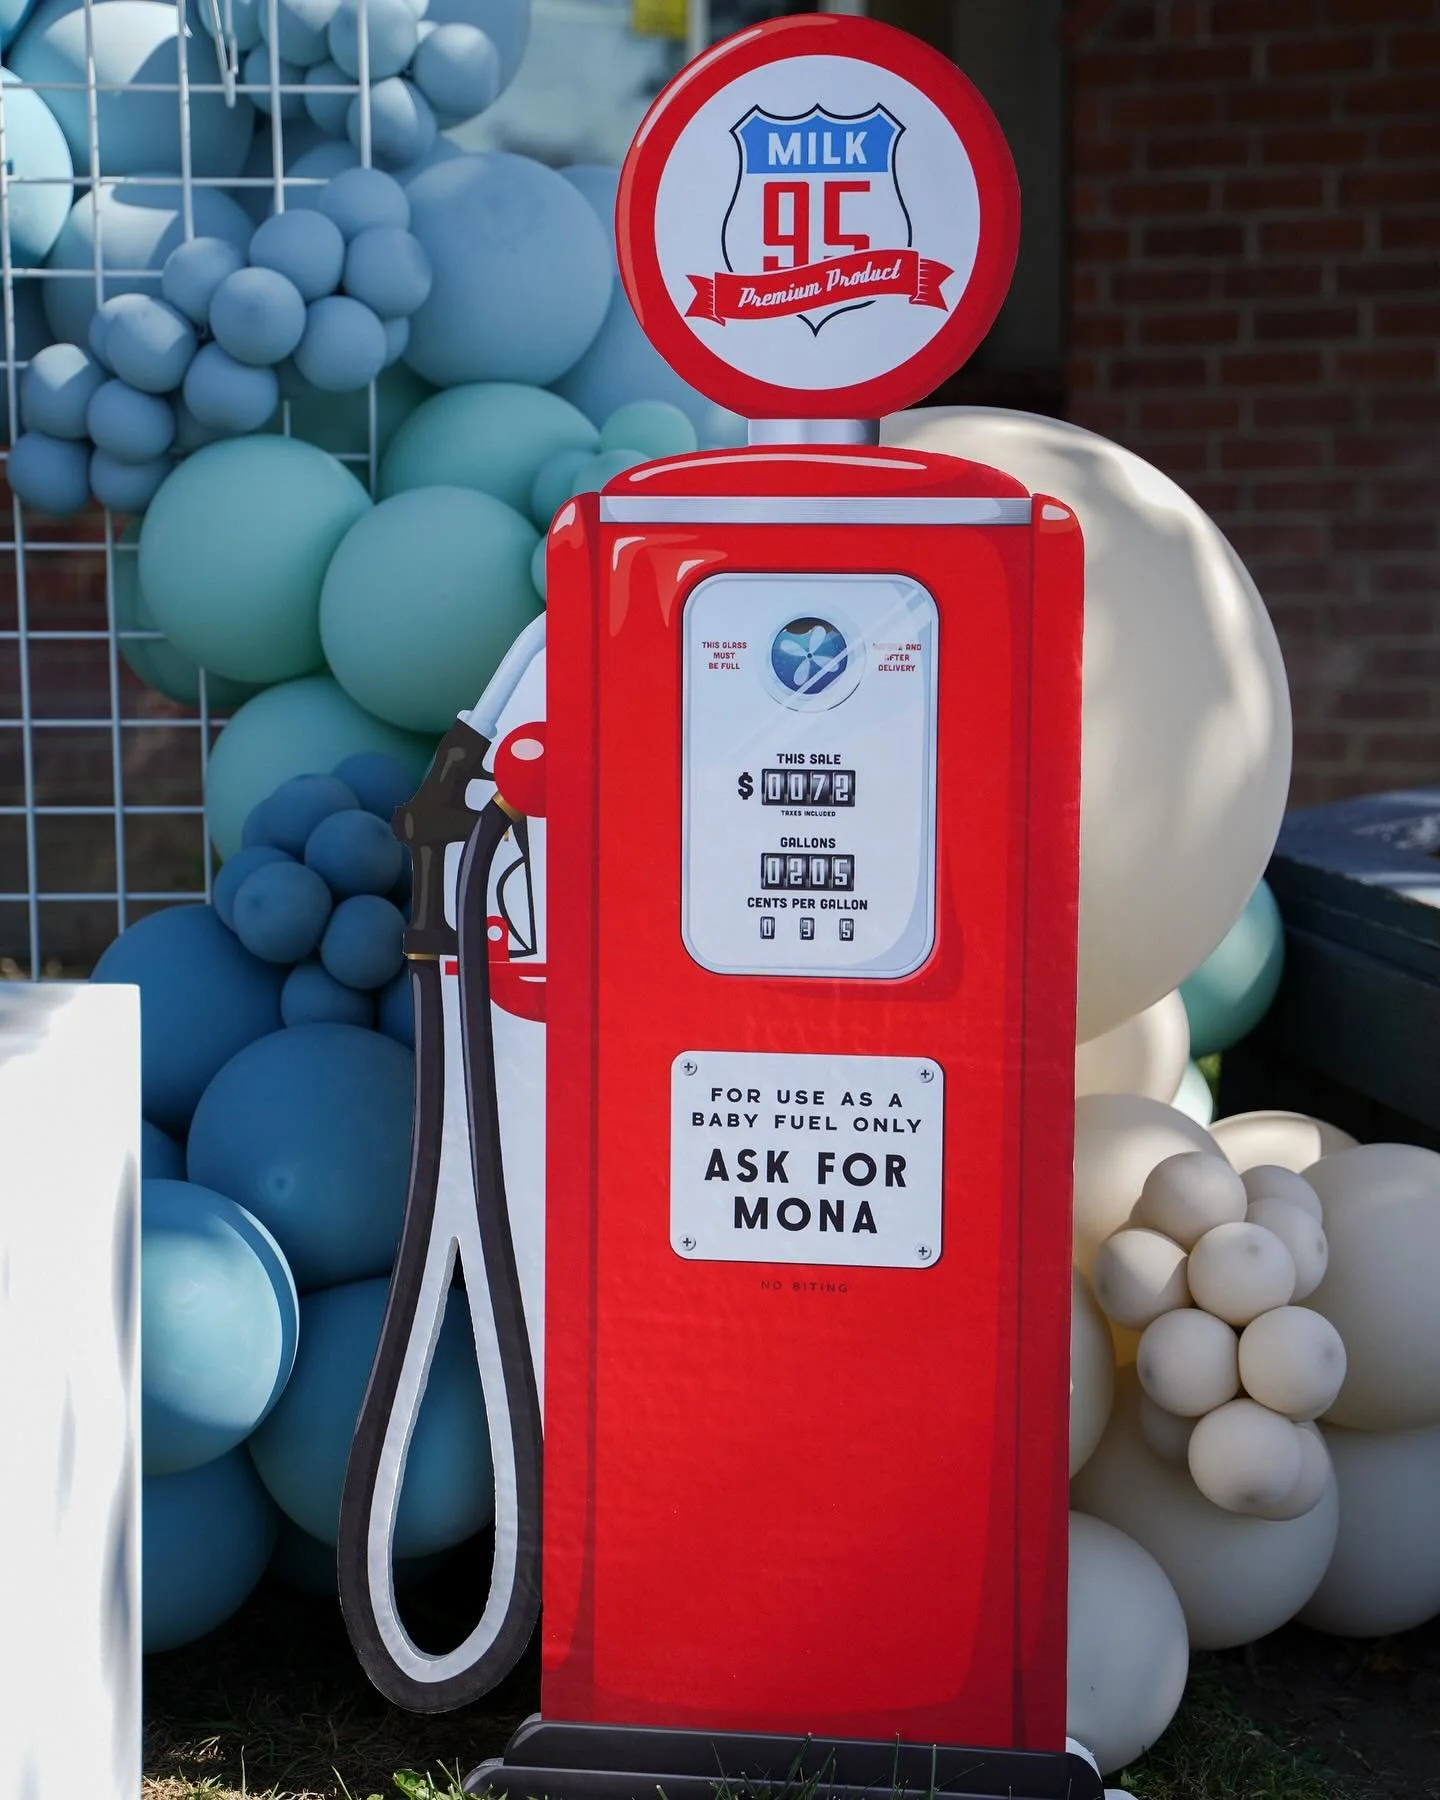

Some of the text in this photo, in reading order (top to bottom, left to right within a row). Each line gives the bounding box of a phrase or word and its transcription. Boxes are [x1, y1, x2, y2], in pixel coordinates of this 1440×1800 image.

[768, 131, 867, 166] MILK
[763, 180, 871, 273] 95
[738, 259, 904, 309] Premium Product
[777, 754, 841, 764] THIS SALE
[738, 772, 849, 801] $ 0072
[780, 837, 836, 848] GALLONS
[766, 857, 848, 886] 0205
[748, 897, 867, 910] CENTS PER GALLON
[711, 1088, 902, 1108] FOR USE AS A
[692, 1112, 921, 1133] BABY FUEL ONLY
[705, 1148, 907, 1188] ASK FOR
[734, 1196, 877, 1234] MONA
[761, 1281, 848, 1293] NO BITING
